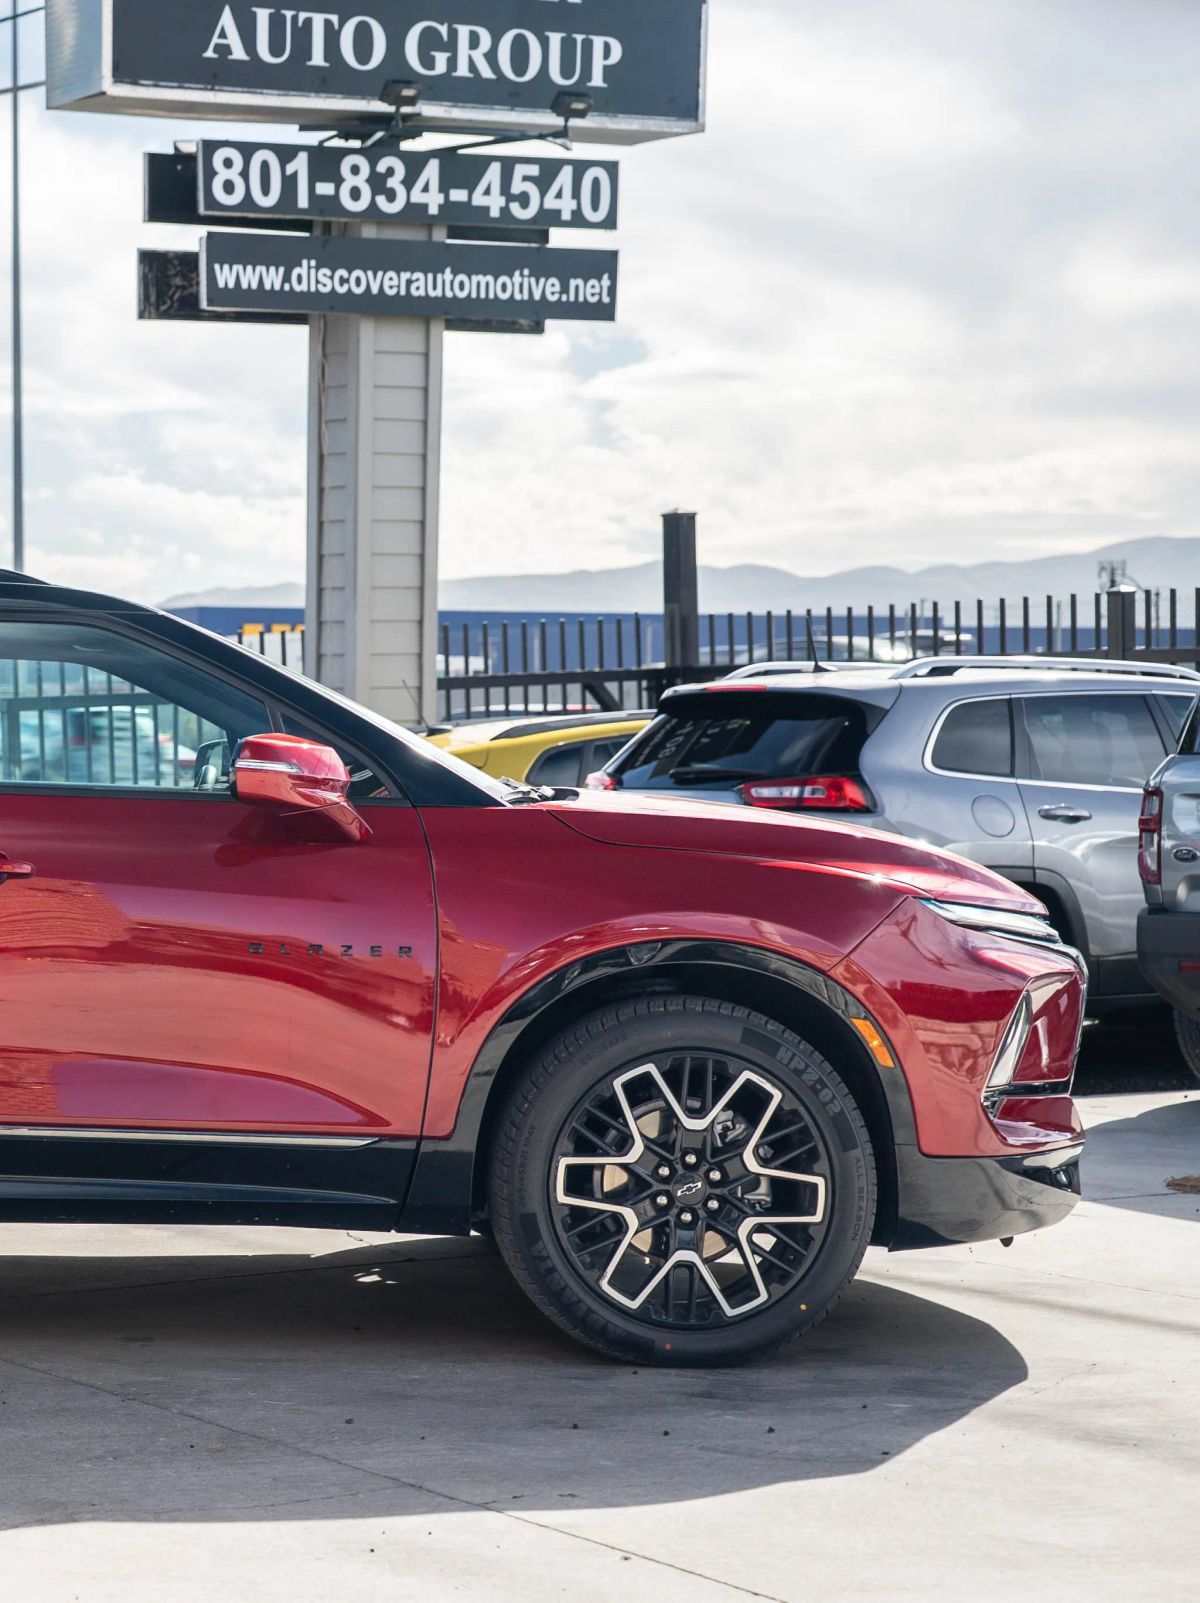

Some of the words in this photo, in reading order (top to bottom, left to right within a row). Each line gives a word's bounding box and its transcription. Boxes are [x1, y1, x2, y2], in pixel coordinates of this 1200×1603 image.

[202, 4, 387, 71] AUTO
[404, 19, 623, 88] GROUP
[211, 146, 611, 223] 801-834-4540
[213, 258, 611, 304] www.discoverautomotive.net
[248, 942, 413, 958] BLAZER
[775, 1045, 842, 1117] HPZ-02
[854, 1155, 865, 1178] ALL
[851, 1186, 866, 1242] SEASON
